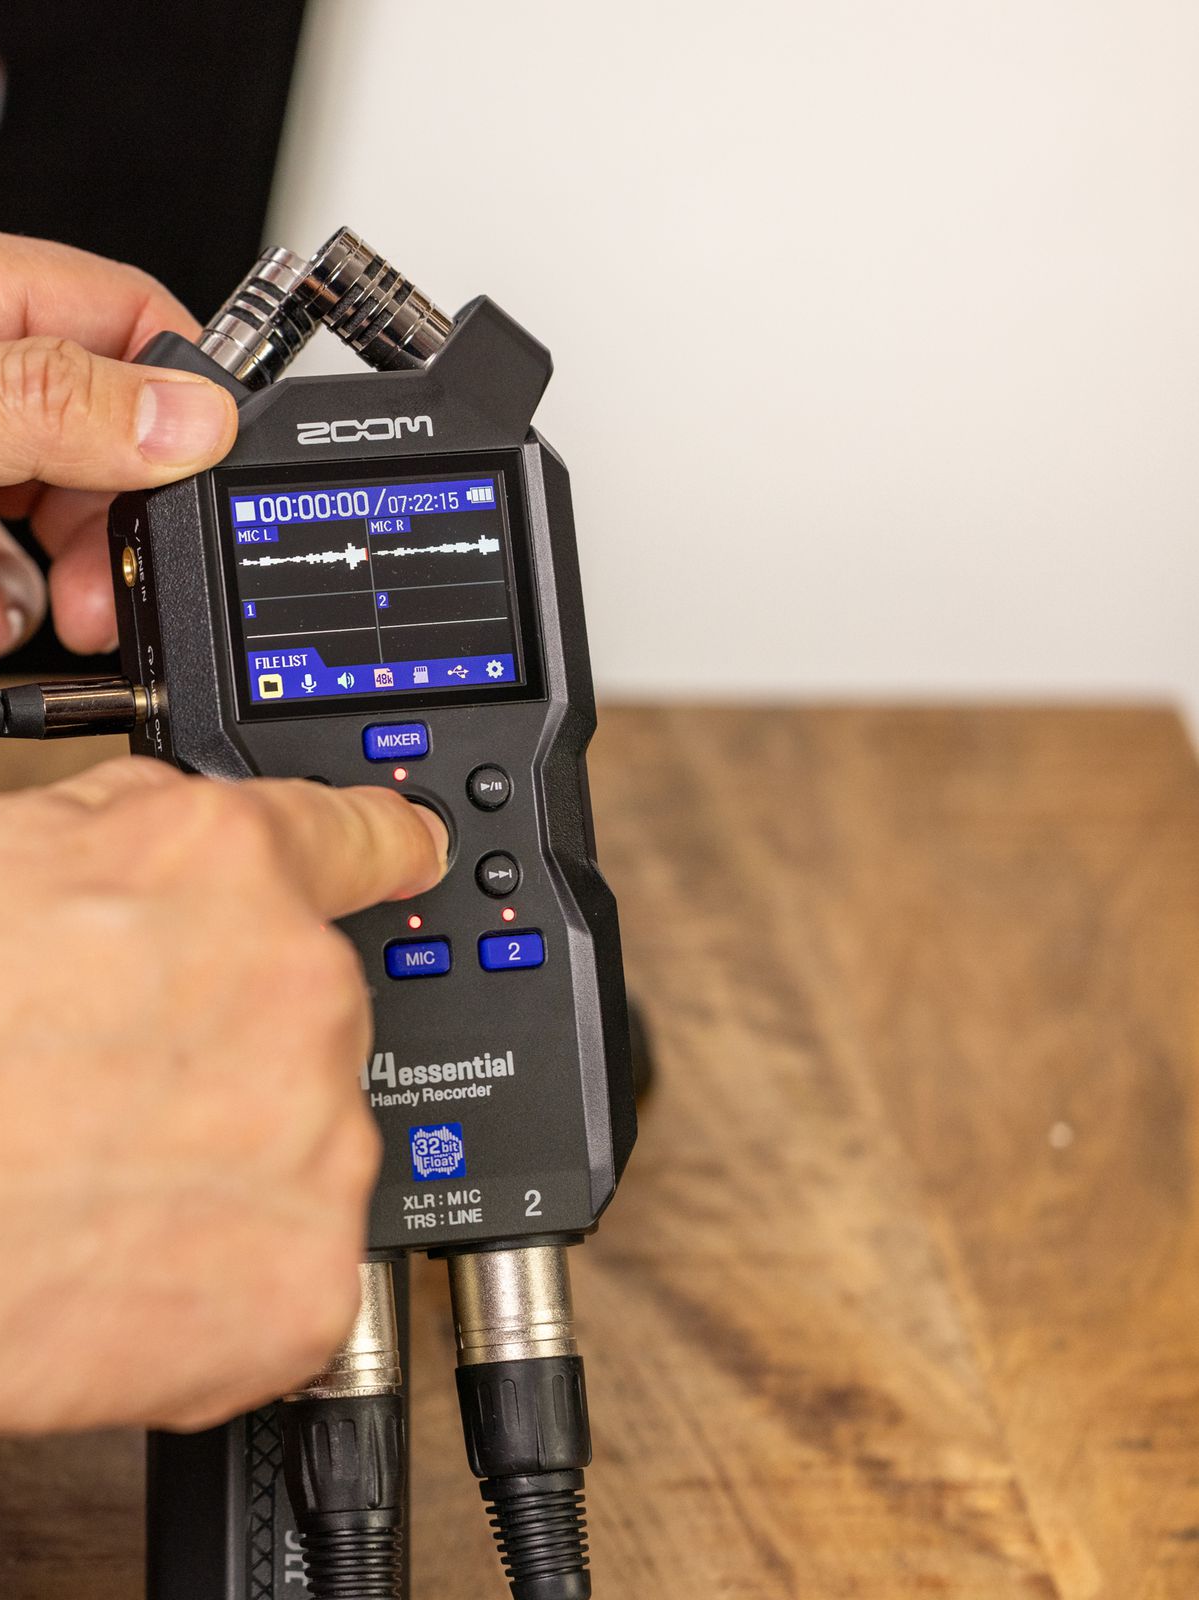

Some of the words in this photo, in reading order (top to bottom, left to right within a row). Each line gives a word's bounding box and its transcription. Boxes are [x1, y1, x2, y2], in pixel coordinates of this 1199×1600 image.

[297, 415, 434, 445] ZOOM
[370, 521, 392, 533] MIC
[396, 519, 405, 531] R
[237, 529, 260, 543] MIC
[263, 528, 272, 541] L
[378, 594, 388, 607] 2
[246, 604, 255, 618] 1
[254, 656, 280, 670] FILE
[282, 653, 308, 667] LIST
[376, 673, 393, 686] 48k
[155, 718, 163, 752] OUT
[376, 732, 421, 748] MIXER
[405, 950, 436, 967] MIC
[507, 942, 522, 961] 2
[370, 1089, 420, 1108] Handy
[422, 1082, 493, 1103] Recorder
[423, 1155, 454, 1169] Float
[524, 1189, 543, 1217] 2
